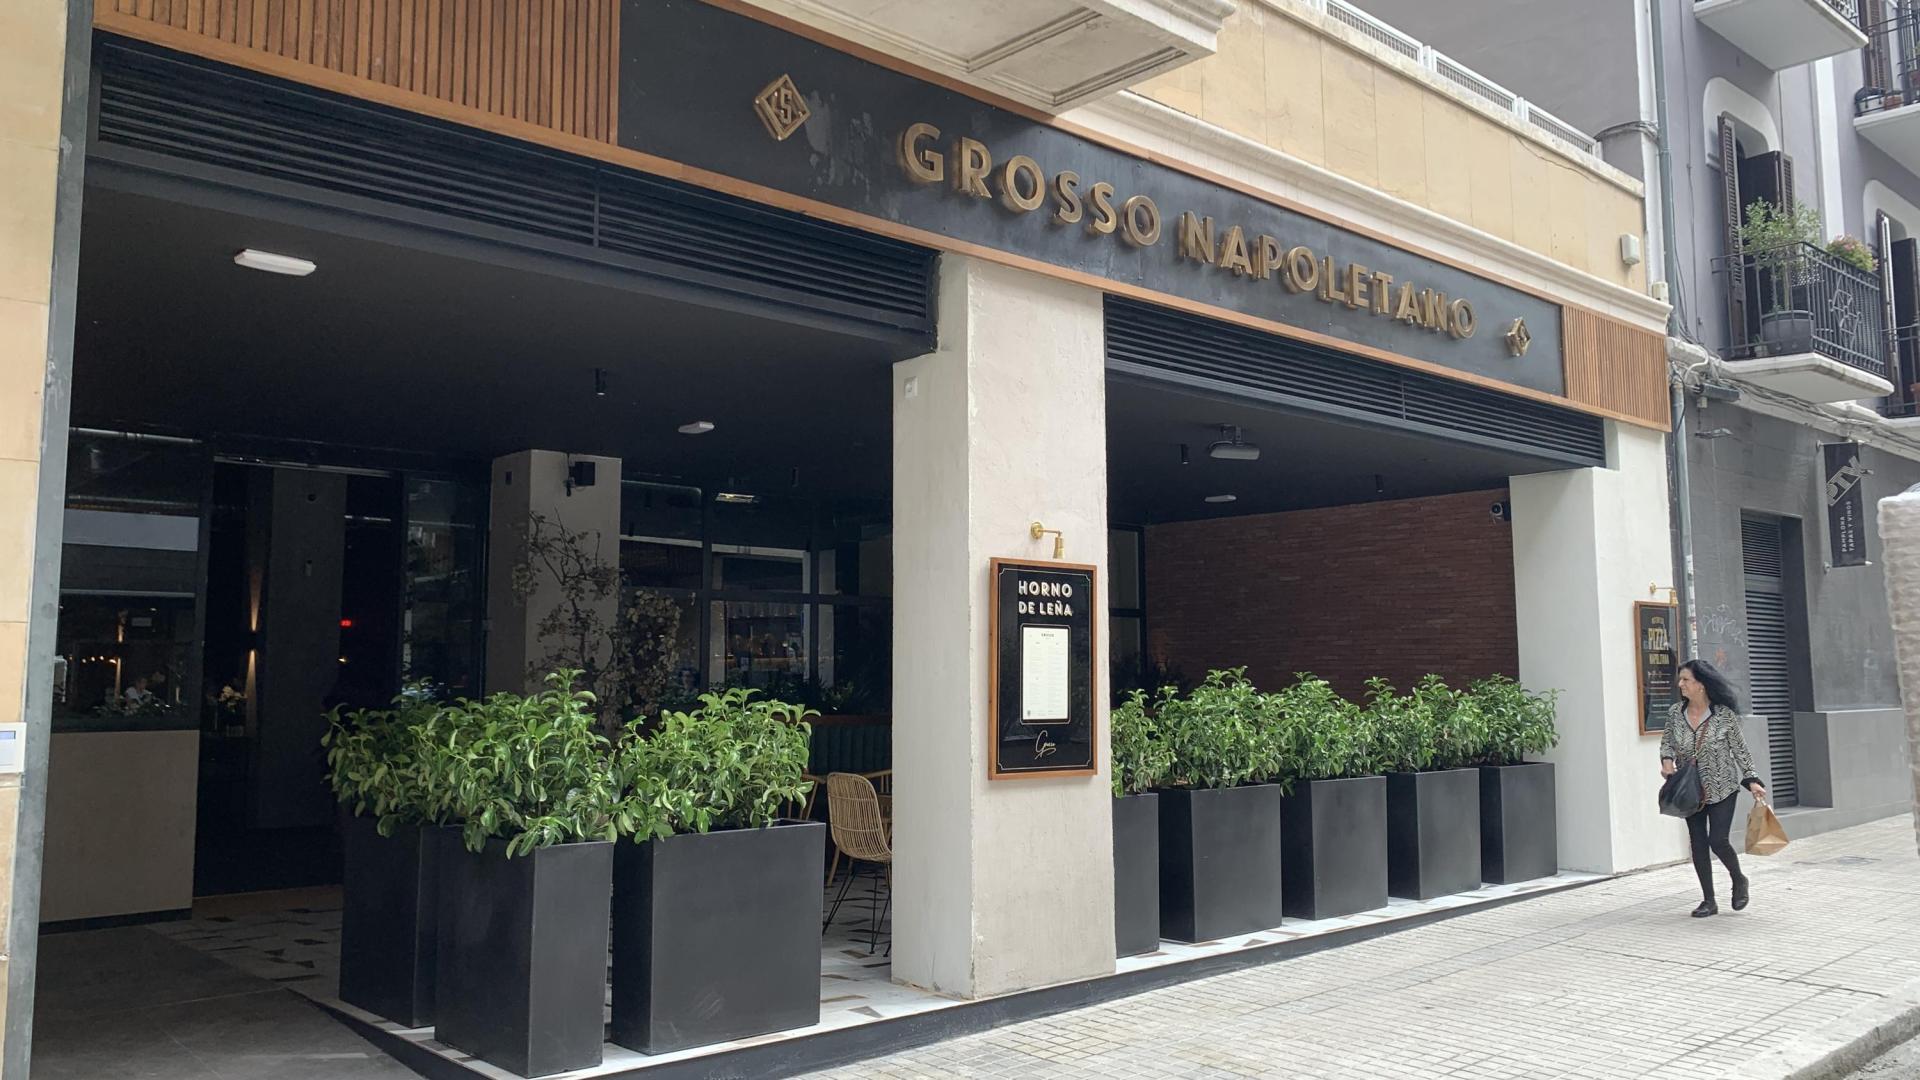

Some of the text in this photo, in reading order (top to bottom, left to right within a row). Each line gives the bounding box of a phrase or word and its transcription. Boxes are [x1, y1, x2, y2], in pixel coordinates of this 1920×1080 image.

[902, 123, 1478, 339] GROSSO NAPOLETANO
[1018, 580, 1073, 598] HORNO
[1018, 600, 1073, 616] DE LEÑA
[1648, 628, 1669, 650] PIZZA
